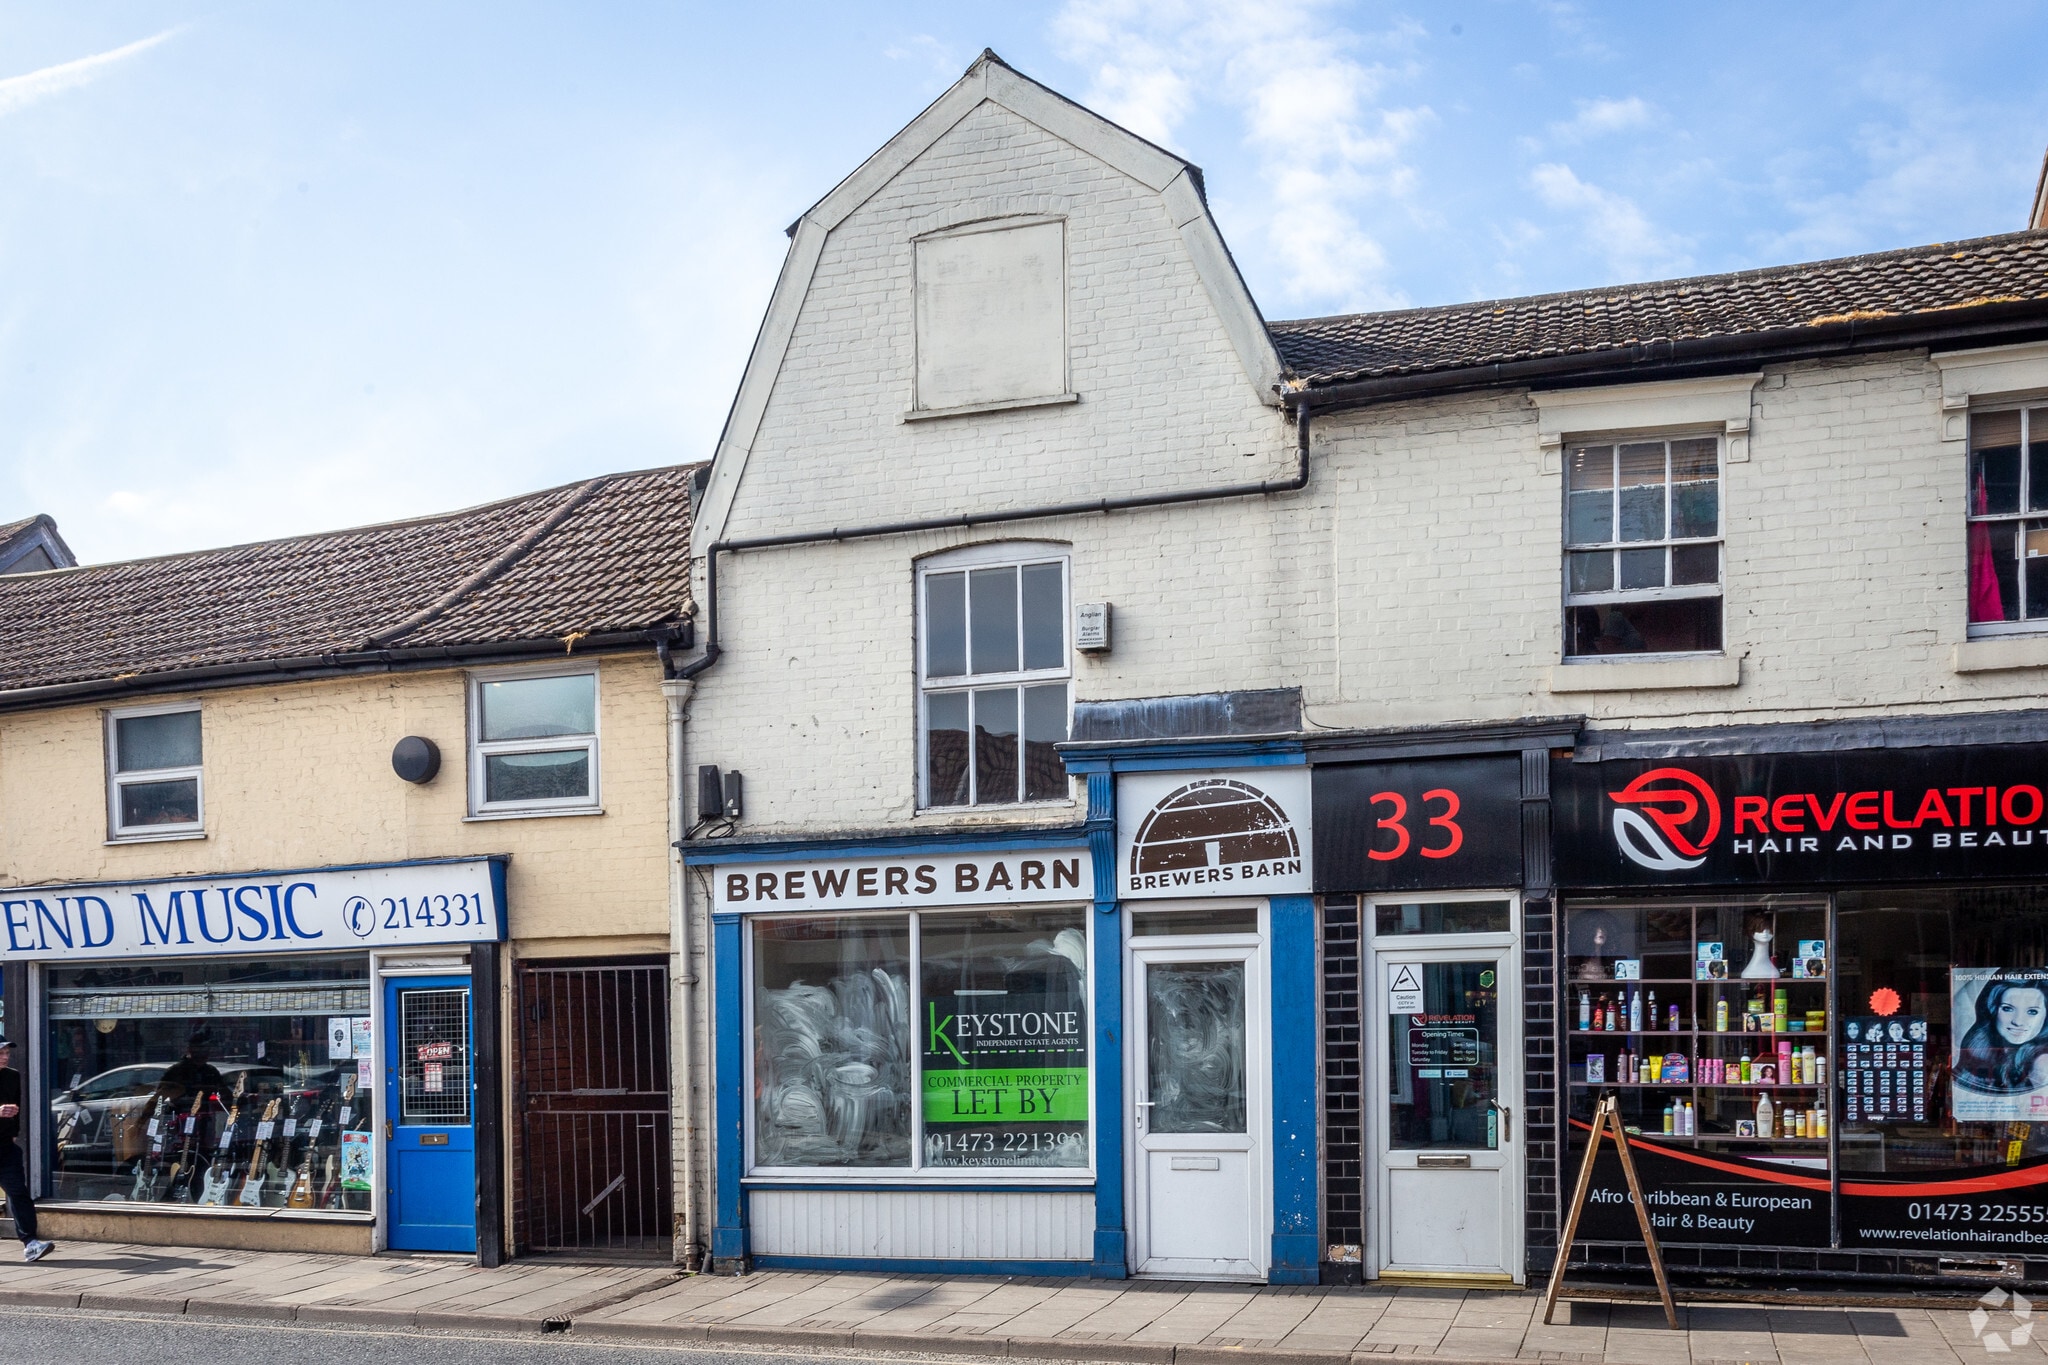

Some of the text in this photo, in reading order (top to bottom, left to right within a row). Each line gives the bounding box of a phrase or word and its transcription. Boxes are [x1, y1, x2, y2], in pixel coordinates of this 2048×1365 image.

[1734, 784, 2048, 835] REVELATIO
[1367, 788, 1464, 861] 33
[1733, 838, 1819, 854] HAIR
[1836, 834, 1913, 850] AND
[726, 858, 1080, 902] BREWERS BARN
[1130, 860, 1302, 891] BREWERS BARN
[1, 882, 487, 952] END MUSIC 214331
[1974, 973, 2003, 981] HUMAN
[929, 1001, 1079, 1065] KEYSTONE
[976, 1037, 1079, 1047] INDEPENDENT ESTATE AGENTS
[1421, 1031, 1447, 1039] Opening
[426, 1046, 451, 1057] OPEN
[927, 1073, 1083, 1088] COMMERCIAL PROPERTY
[951, 1087, 1060, 1115] LET BY
[931, 1132, 995, 1152] 01473
[1590, 1188, 1624, 1204] Afro
[1715, 1192, 1728, 1207] &
[1731, 1192, 1812, 1212] European
[1908, 1202, 2048, 1223] 01473 22555
[1681, 1213, 1694, 1228] &
[1697, 1214, 1755, 1234] Beauty
